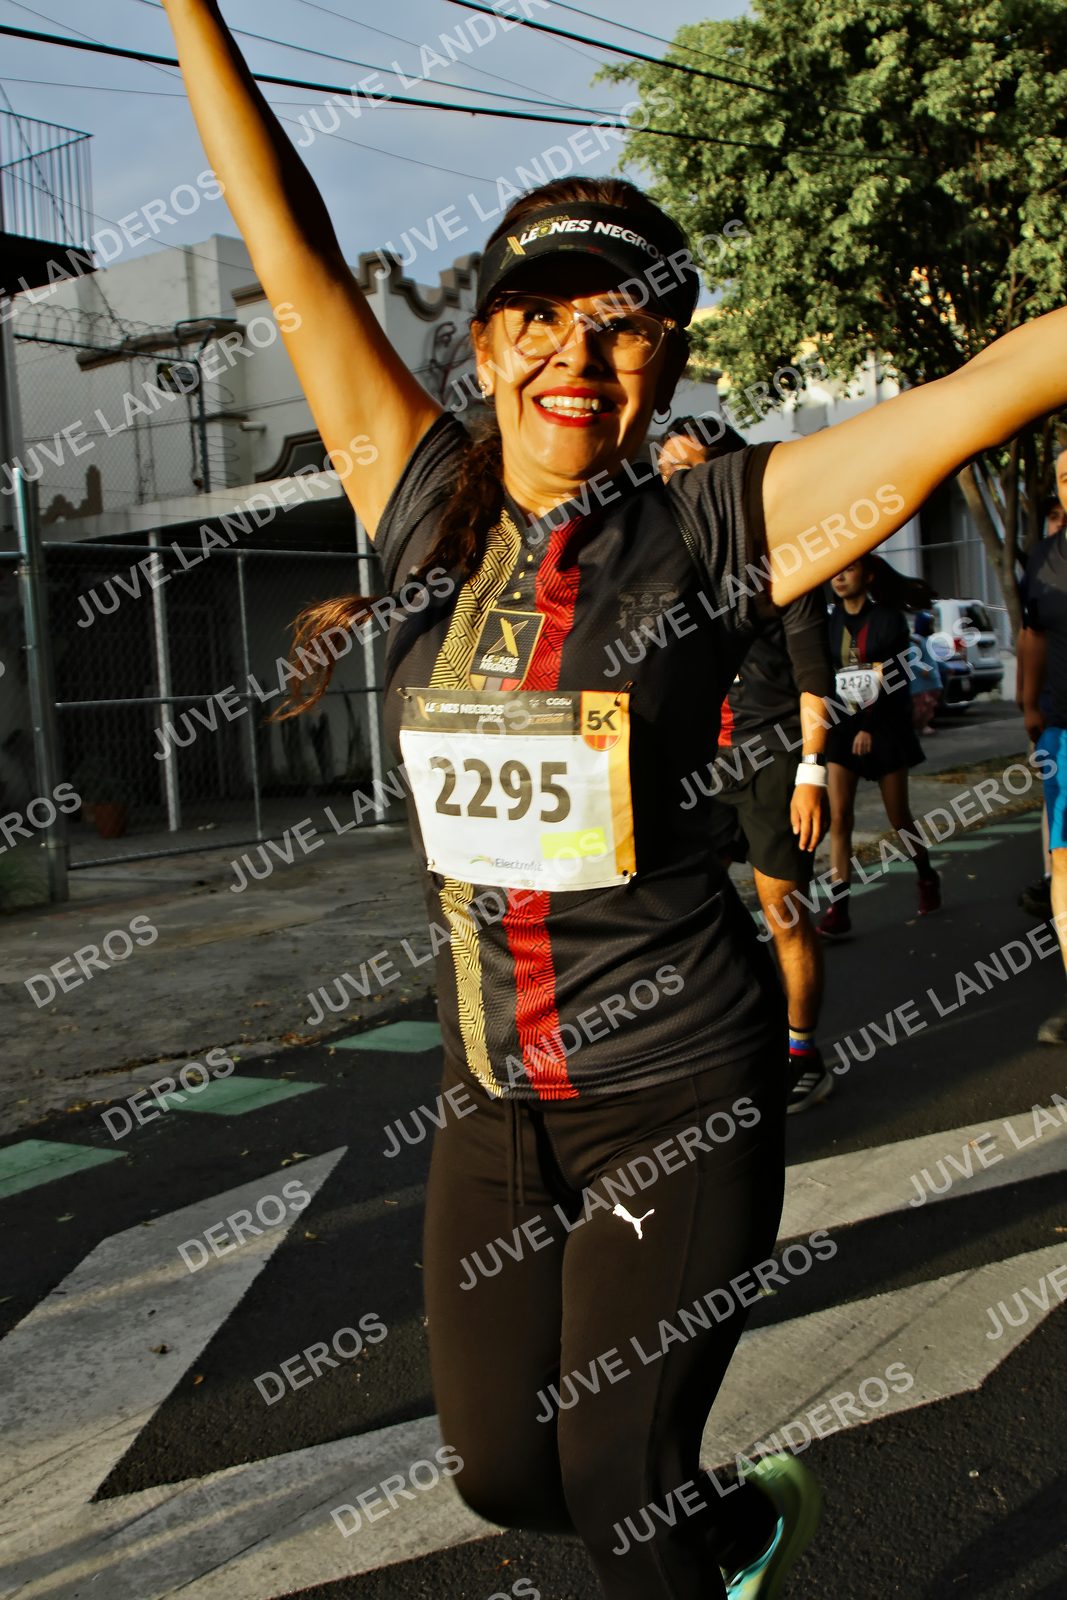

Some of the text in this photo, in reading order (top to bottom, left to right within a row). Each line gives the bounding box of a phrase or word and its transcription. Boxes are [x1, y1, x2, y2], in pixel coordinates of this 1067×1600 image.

[840, 674, 872, 691] 2479
[424, 702, 460, 714] LENES
[587, 709, 617, 731] 5K
[428, 755, 571, 824] 2295
